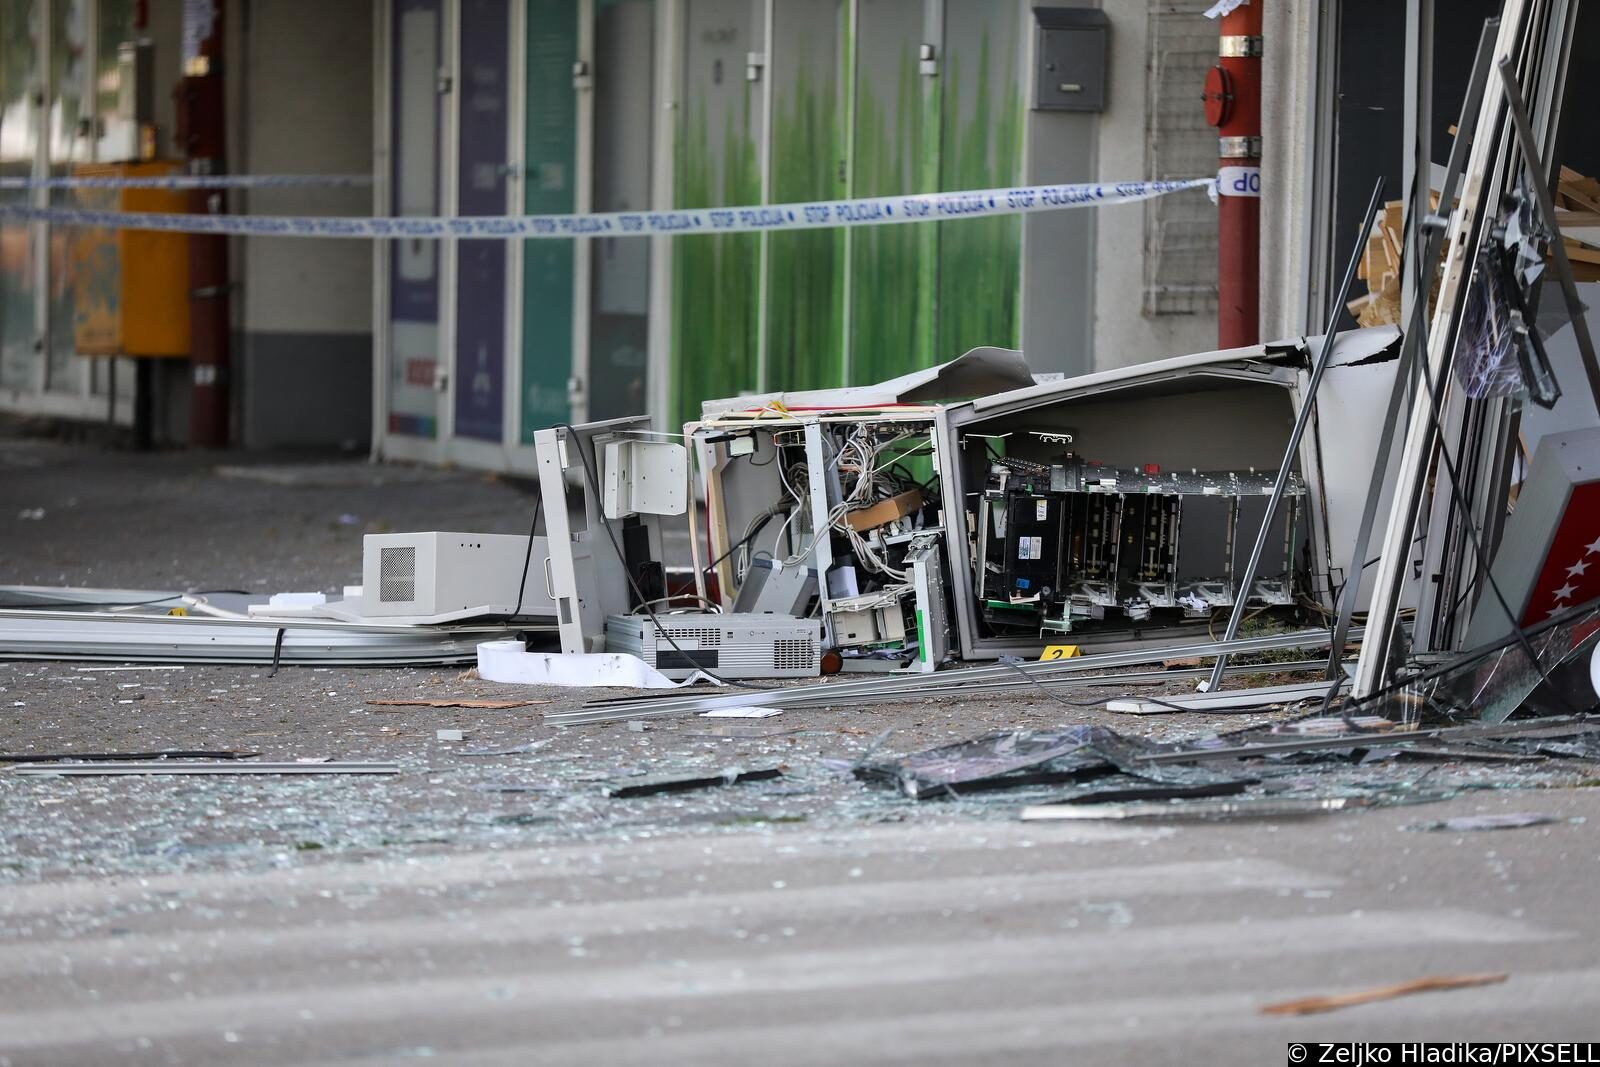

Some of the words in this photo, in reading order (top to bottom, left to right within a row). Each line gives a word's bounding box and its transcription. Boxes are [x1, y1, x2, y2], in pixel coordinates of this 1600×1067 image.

[709, 211, 734, 227] STOP
[803, 206, 830, 223] STOP
[903, 200, 930, 217] STOP
[1007, 190, 1035, 208] STOP
